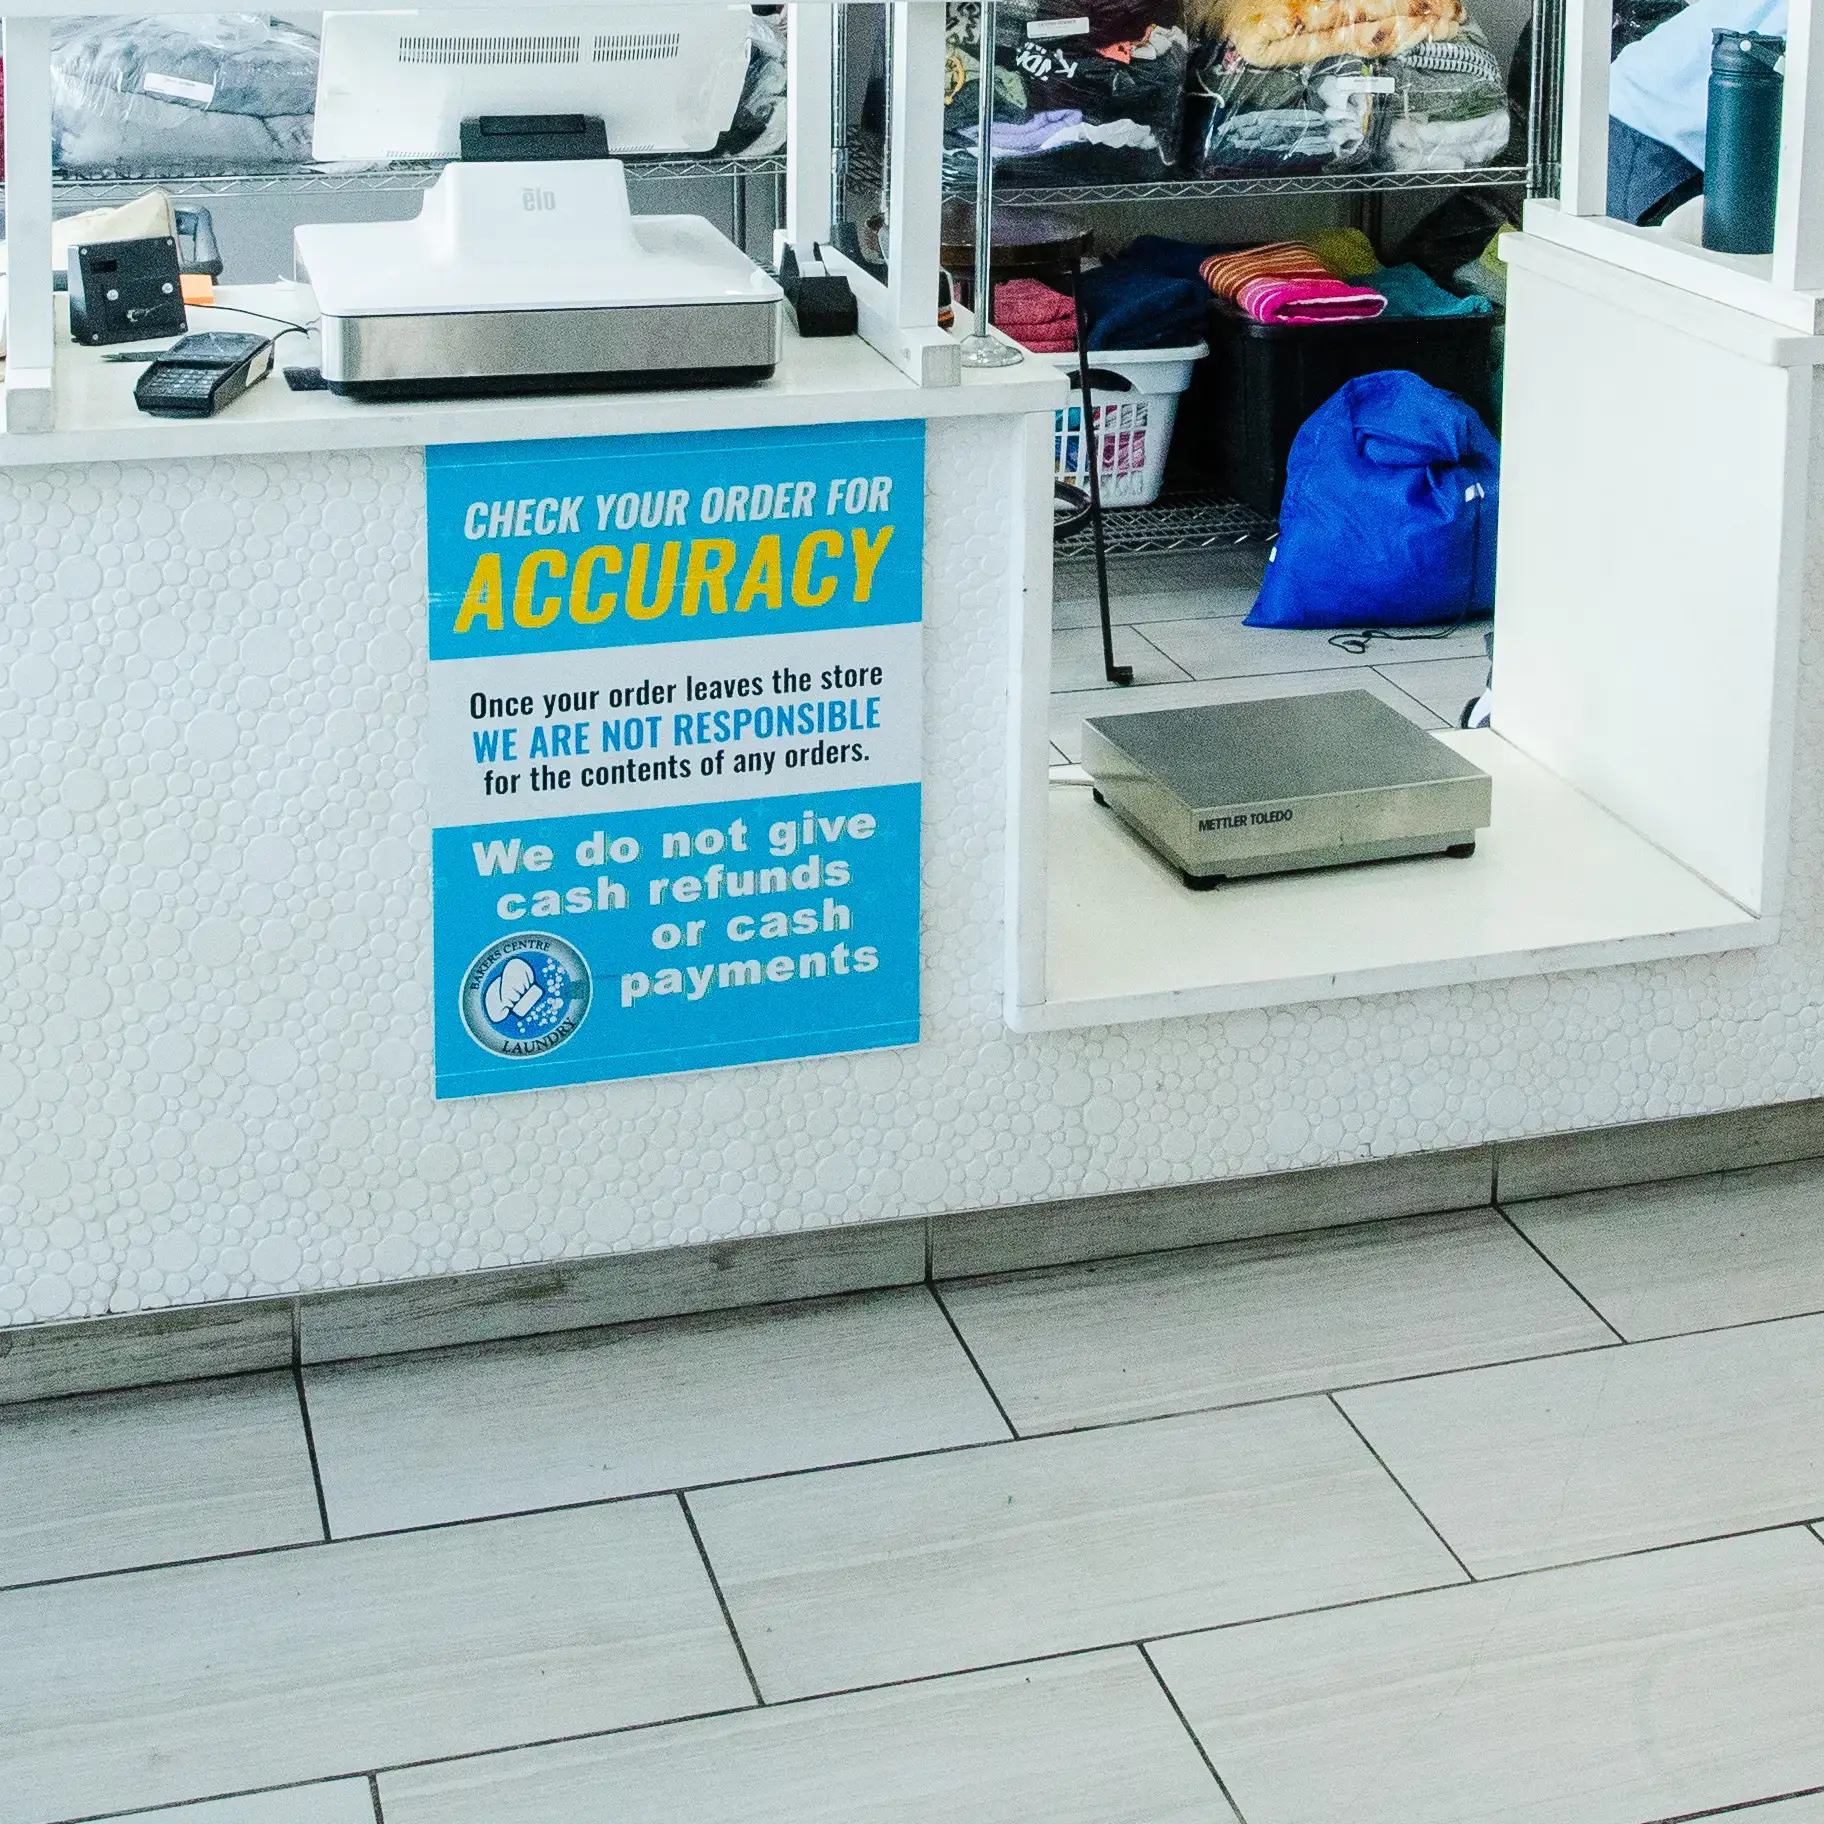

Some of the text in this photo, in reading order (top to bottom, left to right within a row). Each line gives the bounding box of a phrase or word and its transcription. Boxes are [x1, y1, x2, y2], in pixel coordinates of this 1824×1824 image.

[463, 475, 894, 540] CHECK YOUR ORDER FOR
[453, 526, 895, 633] ACCURACY
[470, 664, 883, 720] Once your order leaves the store
[473, 697, 881, 764] WE ARE NOT RESPONSIBLE
[472, 809, 877, 877] We do not give
[1199, 809, 1293, 832] METTLER TOLEDO
[496, 855, 852, 920] cash refunds
[652, 898, 852, 951] or cash
[470, 940, 551, 990] BAKERS CENTRE
[620, 943, 879, 1008] payments
[502, 1017, 576, 1053] LAUNDRY
